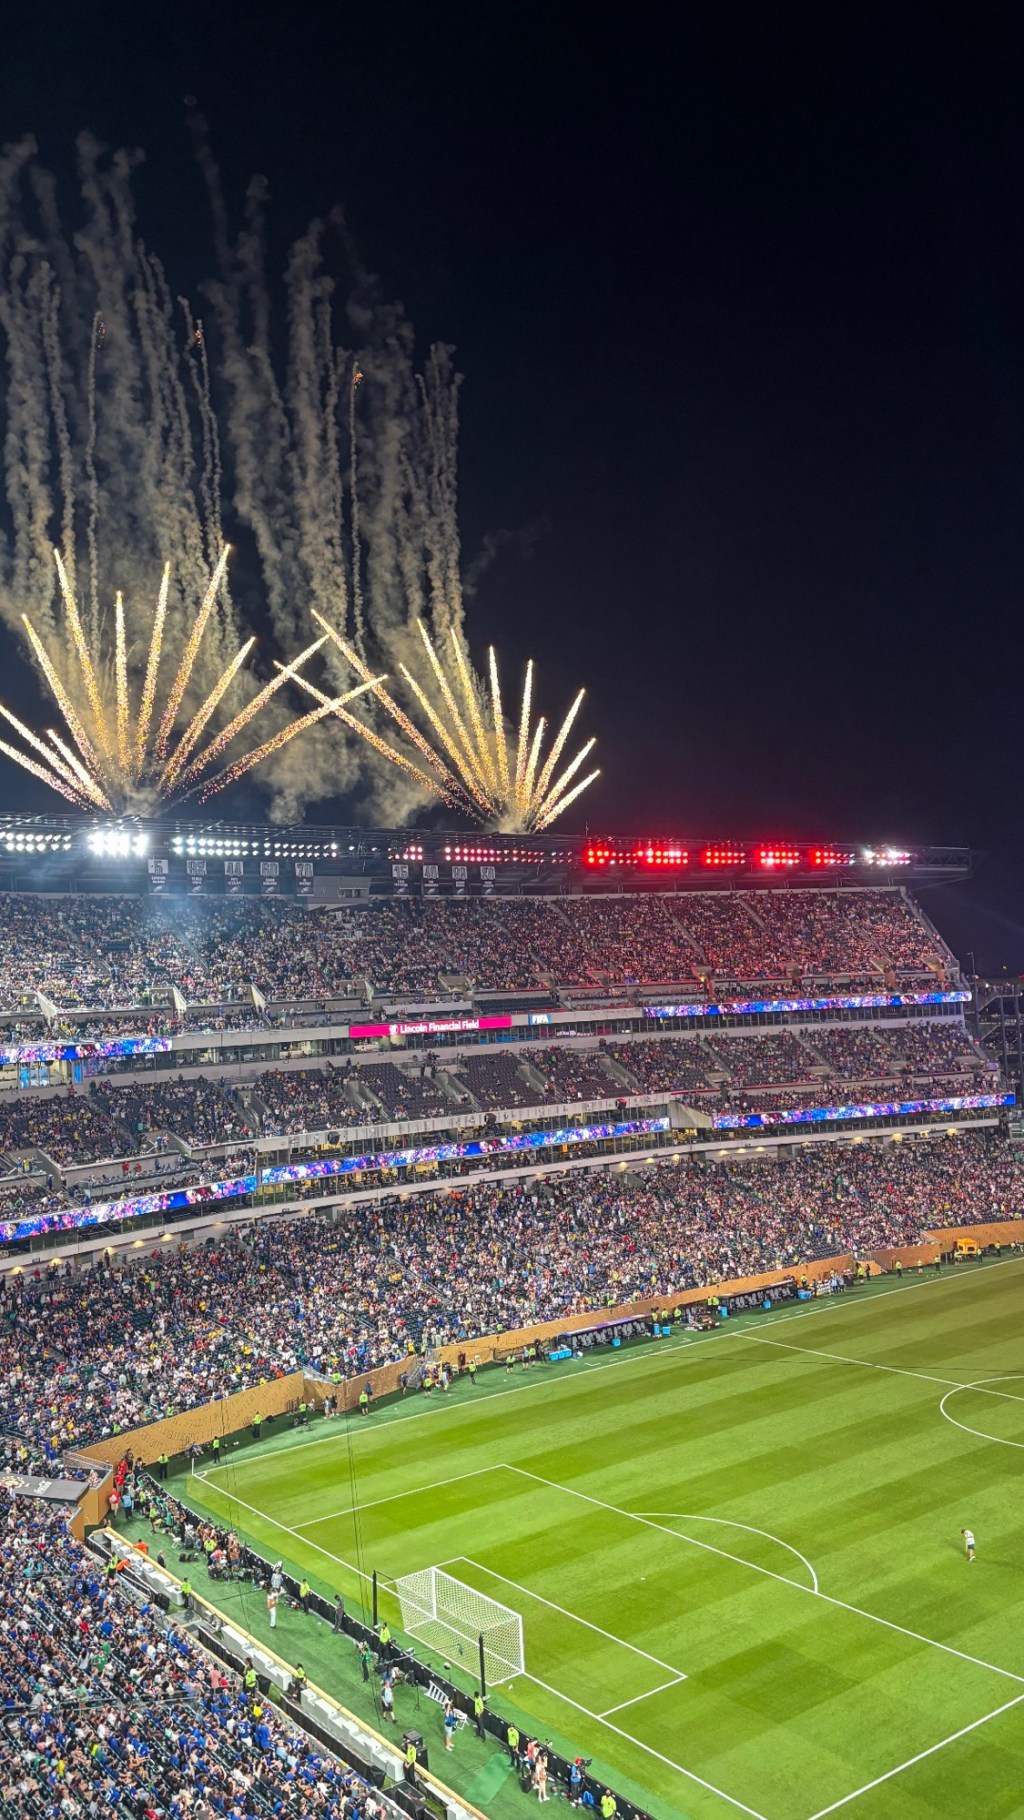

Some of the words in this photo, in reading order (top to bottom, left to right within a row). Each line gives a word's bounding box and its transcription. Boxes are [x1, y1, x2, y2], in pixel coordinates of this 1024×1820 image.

[532, 1014, 550, 1024] FIFA
[400, 1024, 428, 1033] Lincoln
[429, 1021, 461, 1032] Financial
[462, 1019, 480, 1030] Field
